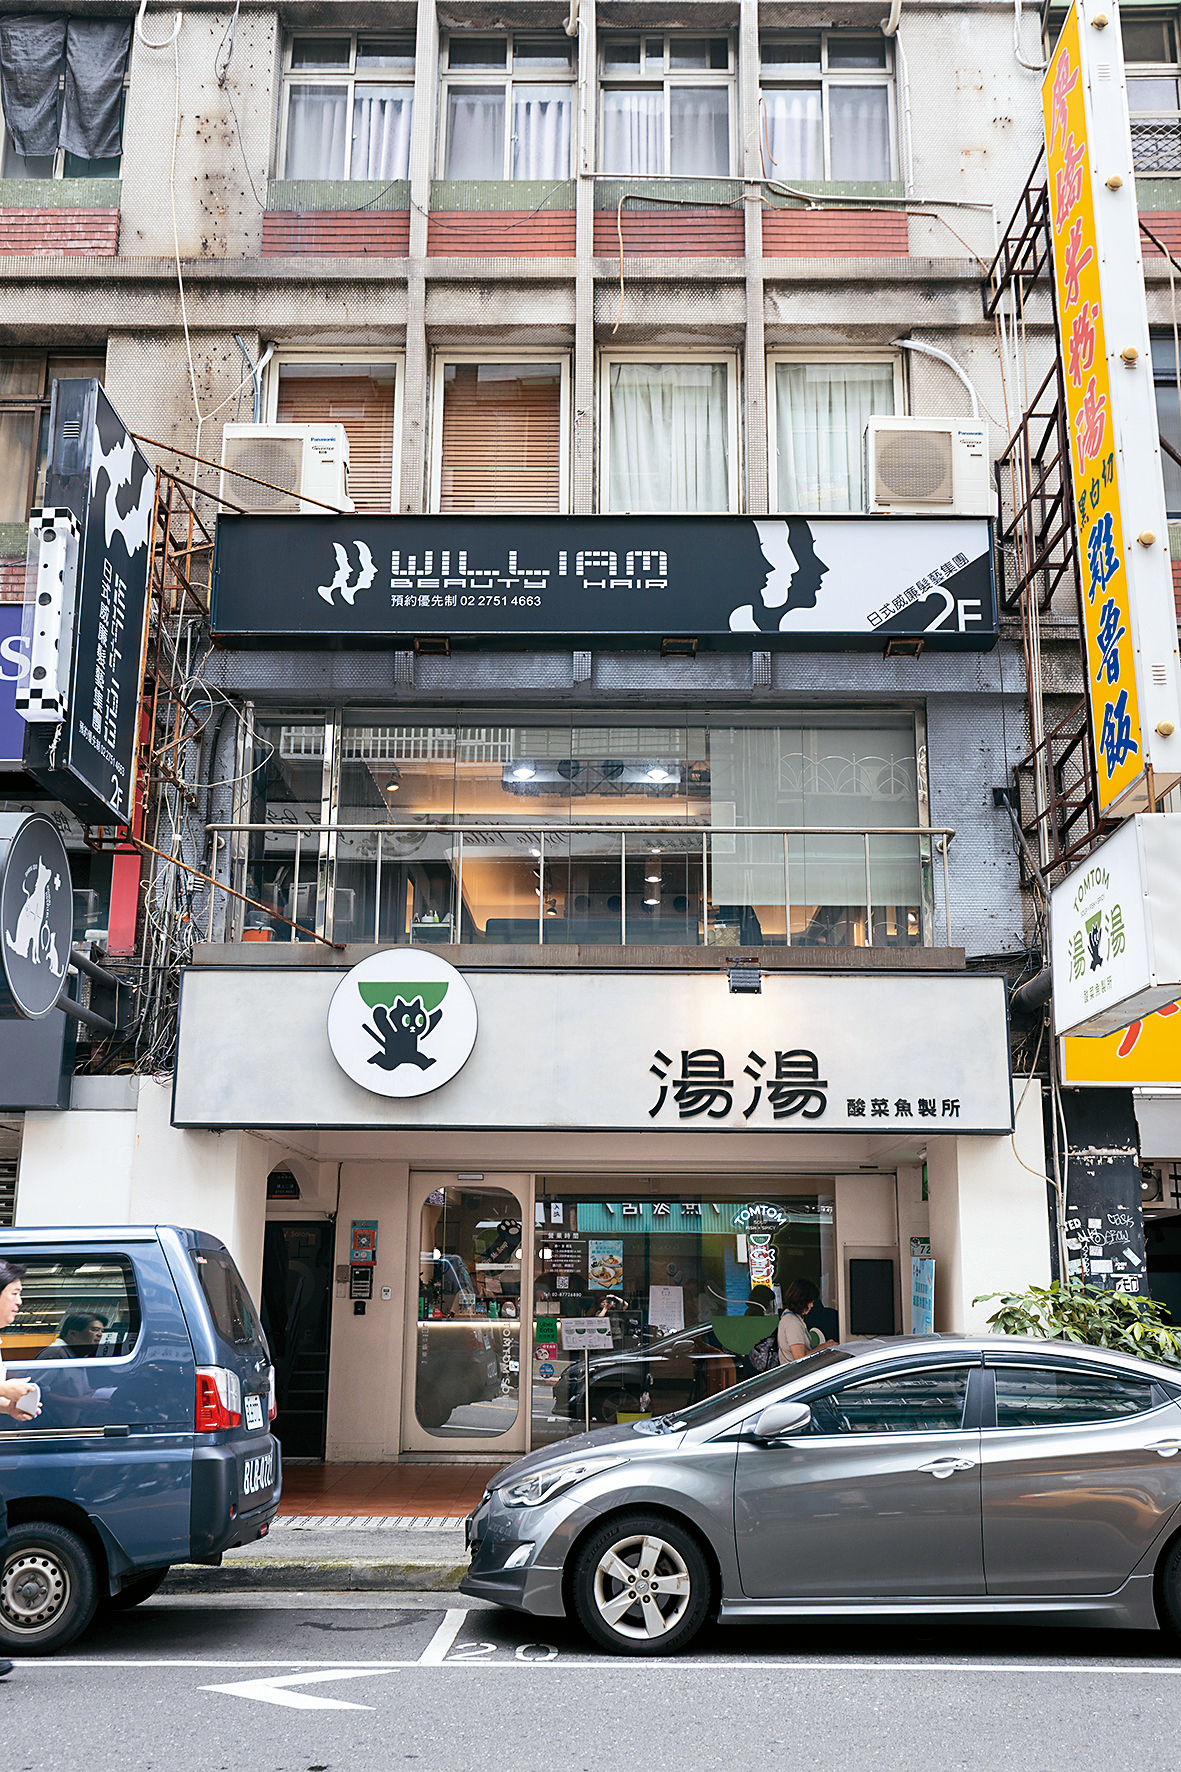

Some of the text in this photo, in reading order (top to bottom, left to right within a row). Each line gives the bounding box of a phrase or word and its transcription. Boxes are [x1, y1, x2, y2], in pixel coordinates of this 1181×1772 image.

[1078, 452, 1114, 533] 黑白切
[390, 578, 668, 589] BEAUTY HAIR
[391, 594, 542, 607] 預約優先制 02 2751 4663
[917, 586, 982, 632] 2F
[1086, 511, 1138, 779] 雞魯飯
[109, 774, 123, 809] 2F
[1073, 867, 1110, 912] TOMTOM
[1105, 904, 1126, 961] 湯
[1068, 930, 1085, 982] 湯
[648, 1049, 961, 1120] 湯湯 酸菜魚製所
[734, 1205, 787, 1225] TOMTOM
